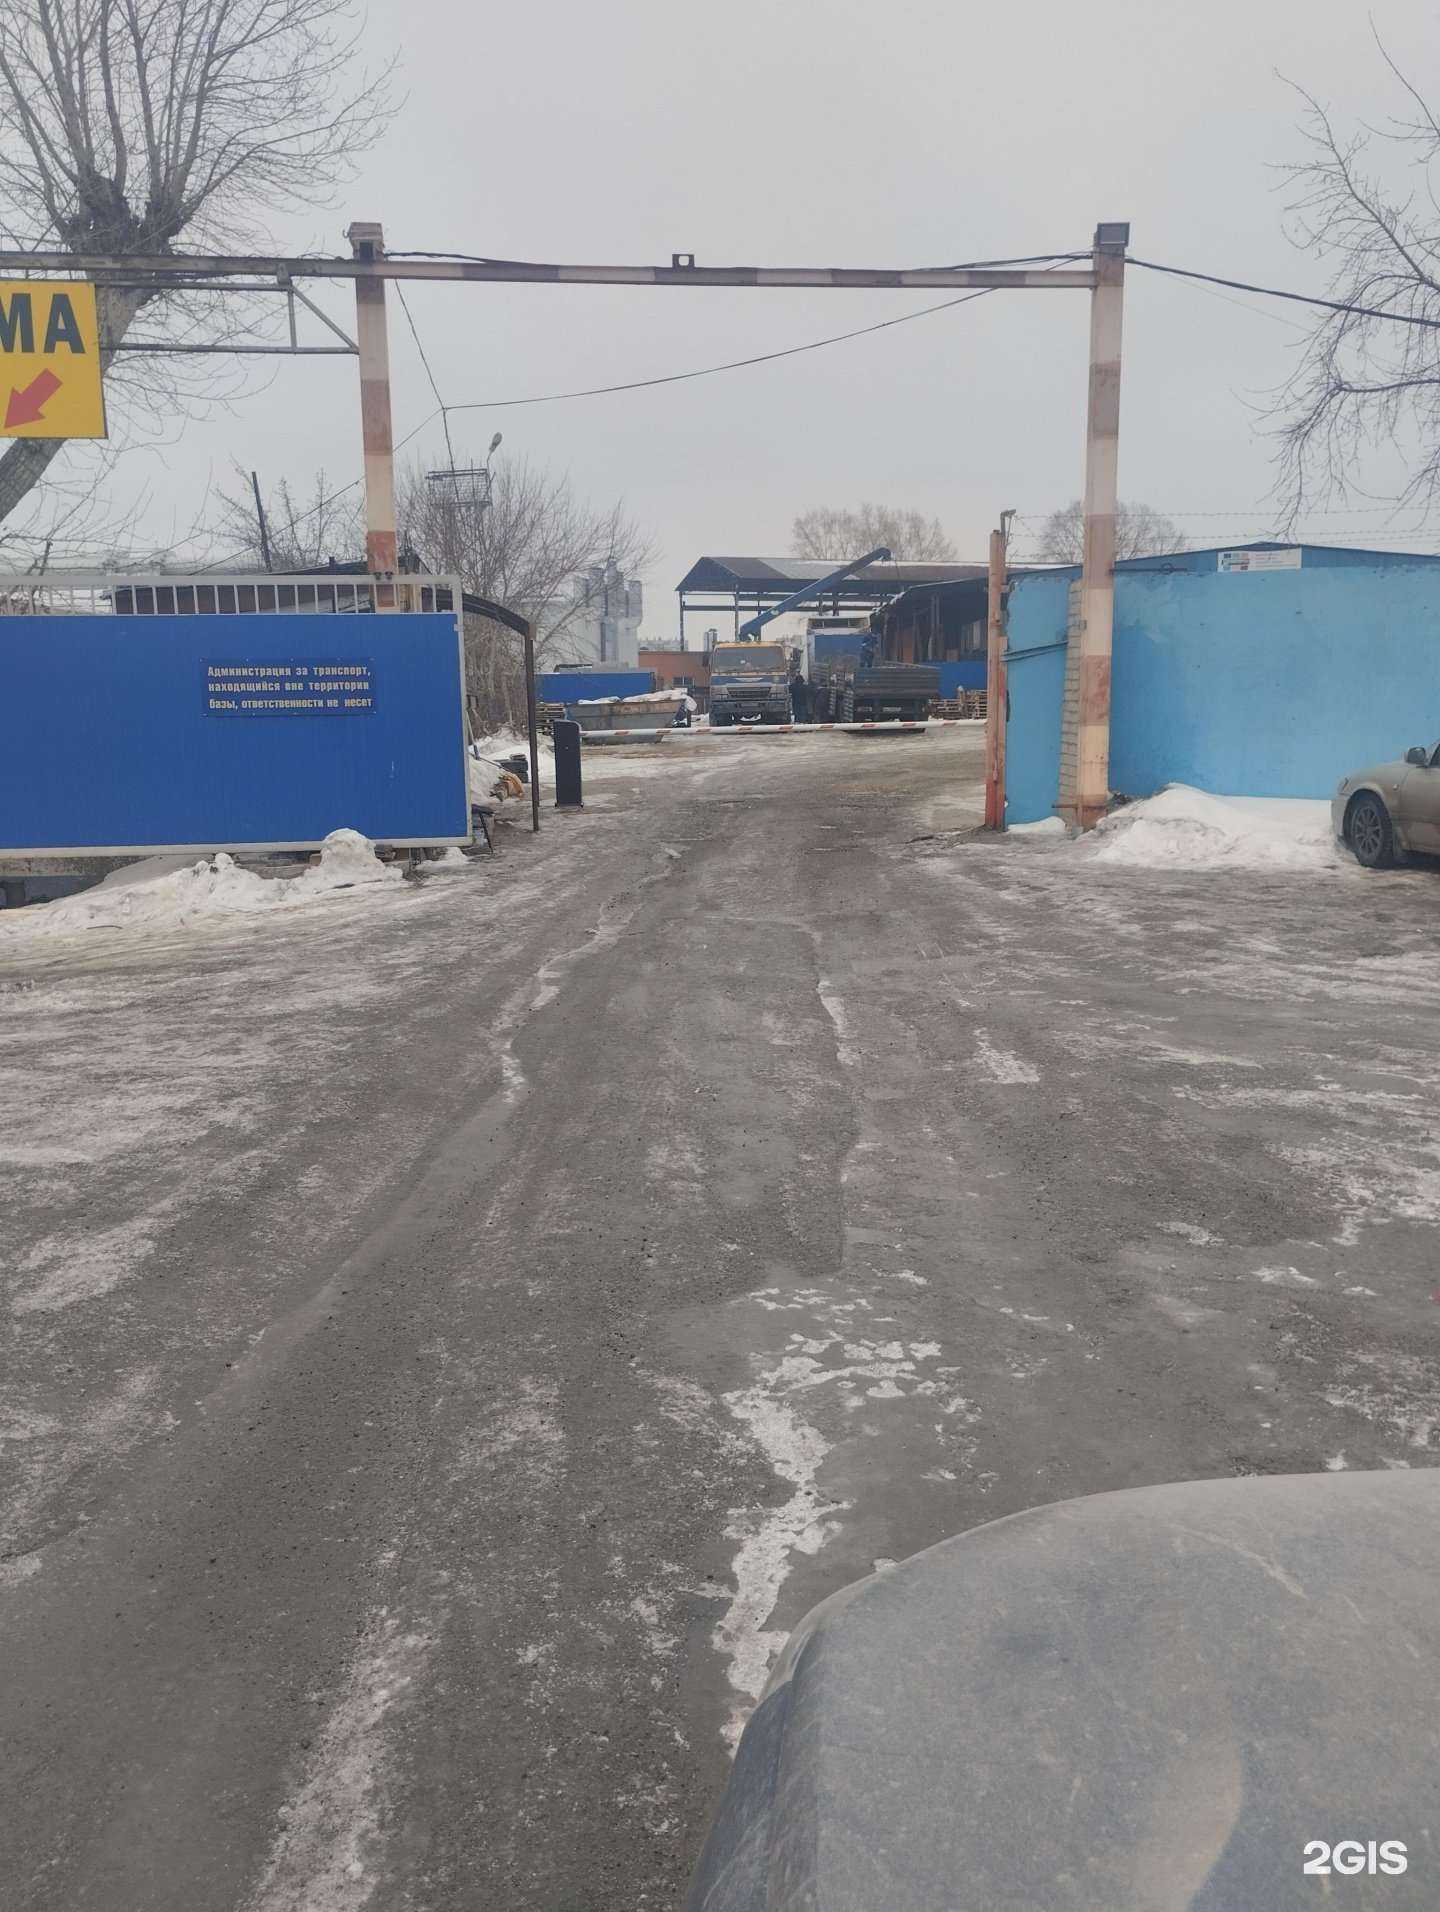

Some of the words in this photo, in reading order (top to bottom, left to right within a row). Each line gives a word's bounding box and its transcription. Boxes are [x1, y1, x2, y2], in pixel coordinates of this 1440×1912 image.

[208, 666, 291, 677] Администрация
[296, 667, 308, 676] за
[313, 666, 371, 677] транспорт,
[208, 681, 281, 692] находящийся
[285, 682, 304, 691] вне
[309, 681, 369, 692] территории
[209, 698, 238, 711] базы,
[241, 698, 324, 709] ответственности
[327, 699, 338, 708] не
[344, 697, 372, 708] несет
